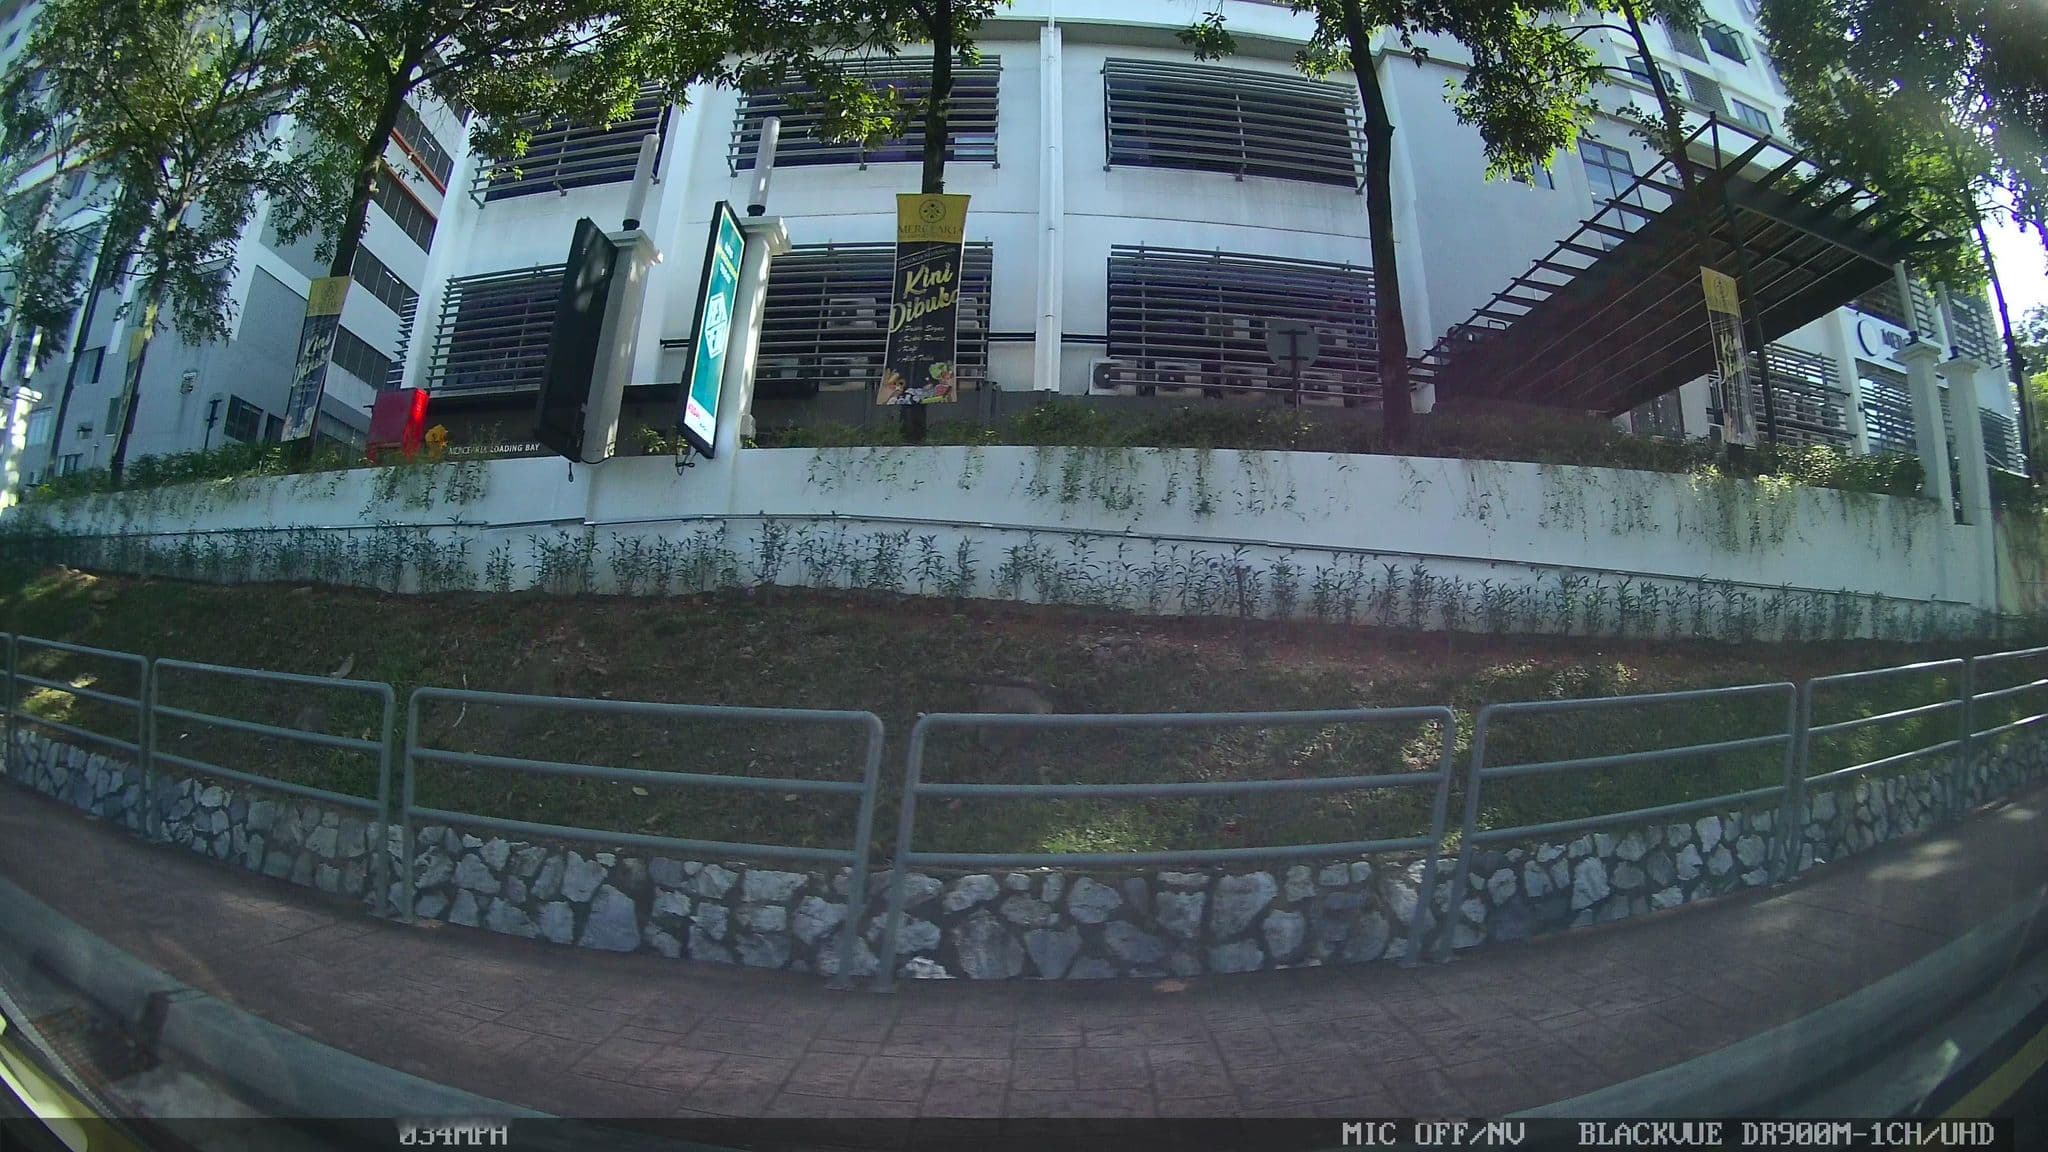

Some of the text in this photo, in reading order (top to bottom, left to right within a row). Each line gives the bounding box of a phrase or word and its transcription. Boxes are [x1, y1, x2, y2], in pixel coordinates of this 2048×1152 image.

[903, 262, 953, 299] Kini
[888, 286, 959, 333] Dibuka
[490, 444, 523, 454] LOADING
[525, 442, 541, 452] BAY
